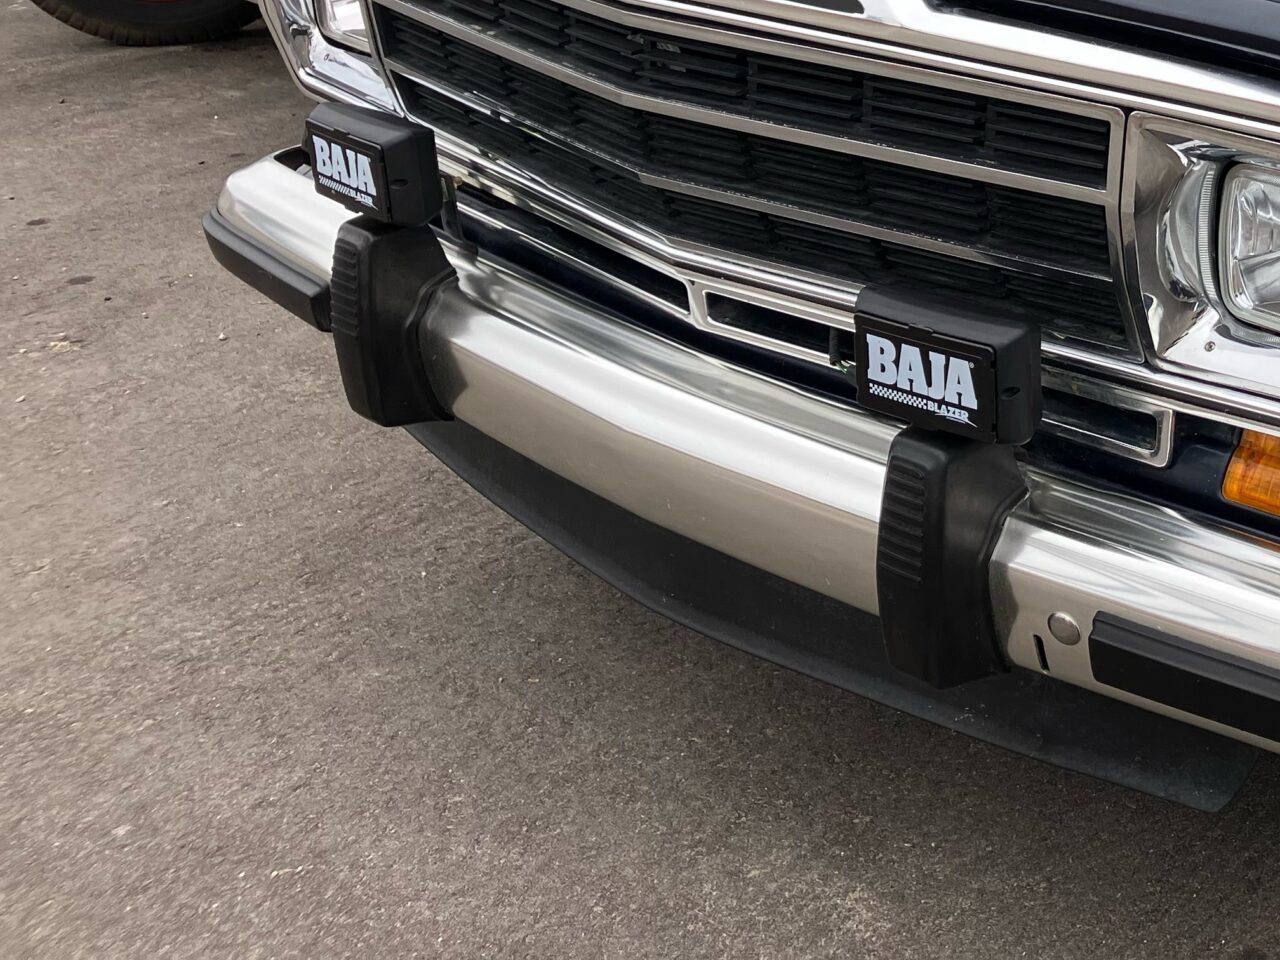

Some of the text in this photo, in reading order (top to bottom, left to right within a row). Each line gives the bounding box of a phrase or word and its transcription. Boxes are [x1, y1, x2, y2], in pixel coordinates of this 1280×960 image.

[312, 134, 377, 197] BAJA
[866, 333, 978, 410] BAJA
[927, 401, 970, 423] BLAZER
